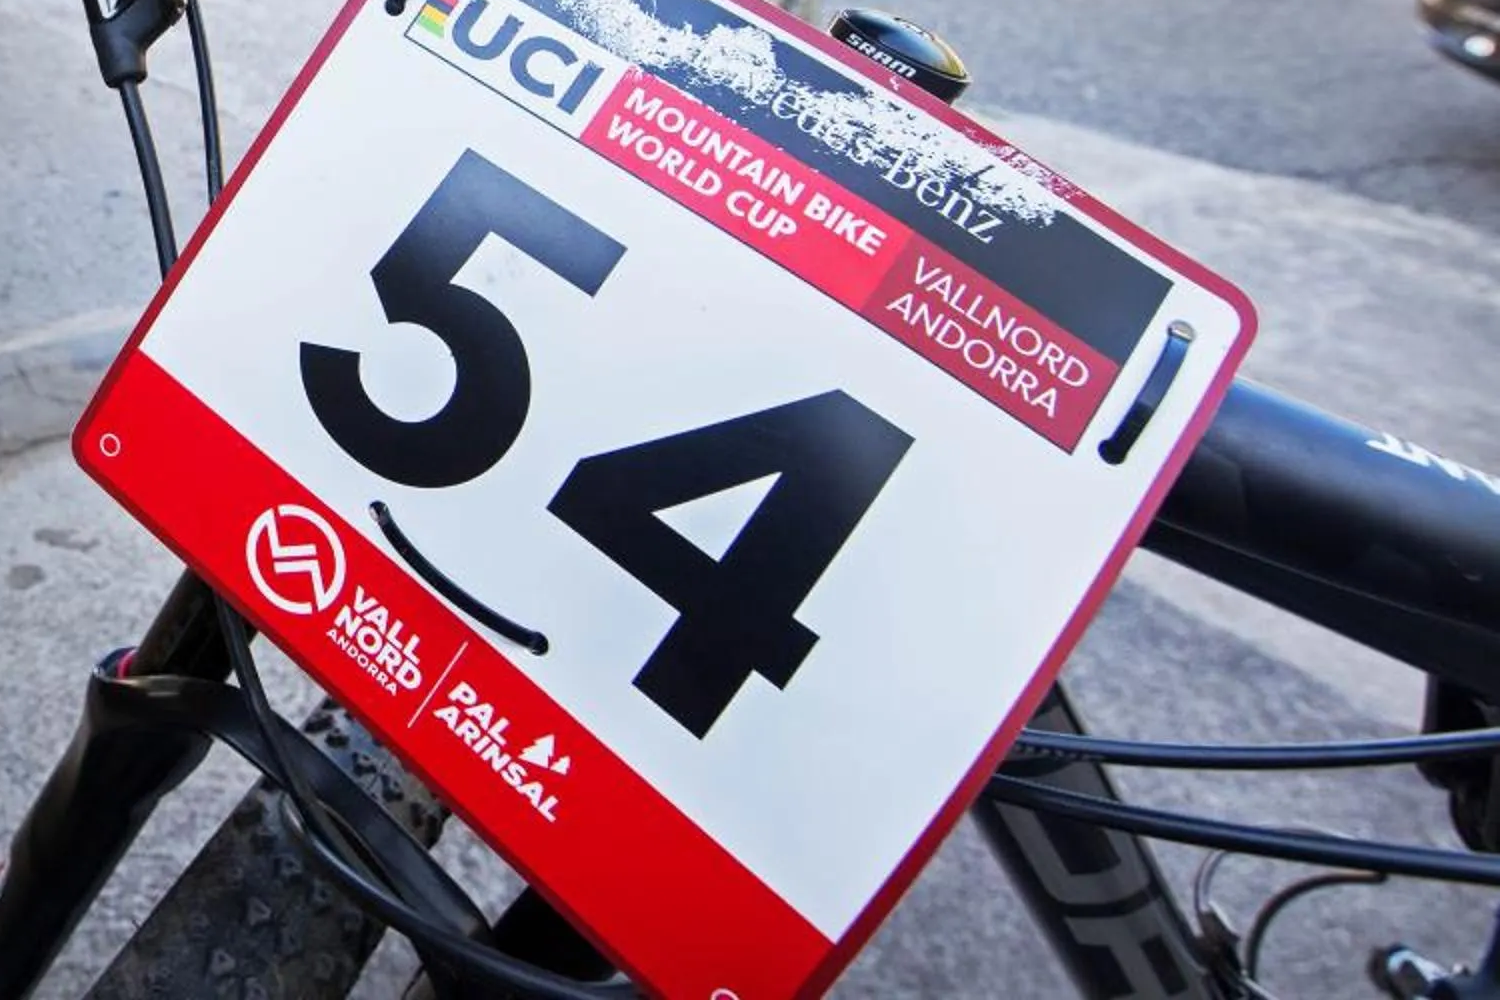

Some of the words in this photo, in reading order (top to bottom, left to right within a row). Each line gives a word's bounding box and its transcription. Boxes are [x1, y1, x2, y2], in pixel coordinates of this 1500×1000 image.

[845, 32, 918, 79] SRAM
[606, 113, 724, 197] WORLD
[725, 190, 798, 239] CUP
[624, 86, 806, 207] MOUNTAIN
[802, 191, 888, 257] BIKE
[885, 292, 1059, 419] ANDORRA
[914, 255, 1091, 388] VALLNORD
[299, 147, 917, 741] 54
[325, 628, 398, 698] ANDORRA
[333, 604, 423, 690] NORD
[353, 584, 421, 666] VALL
[433, 705, 560, 824] ARINSAL
[447, 680, 510, 747] PAL
